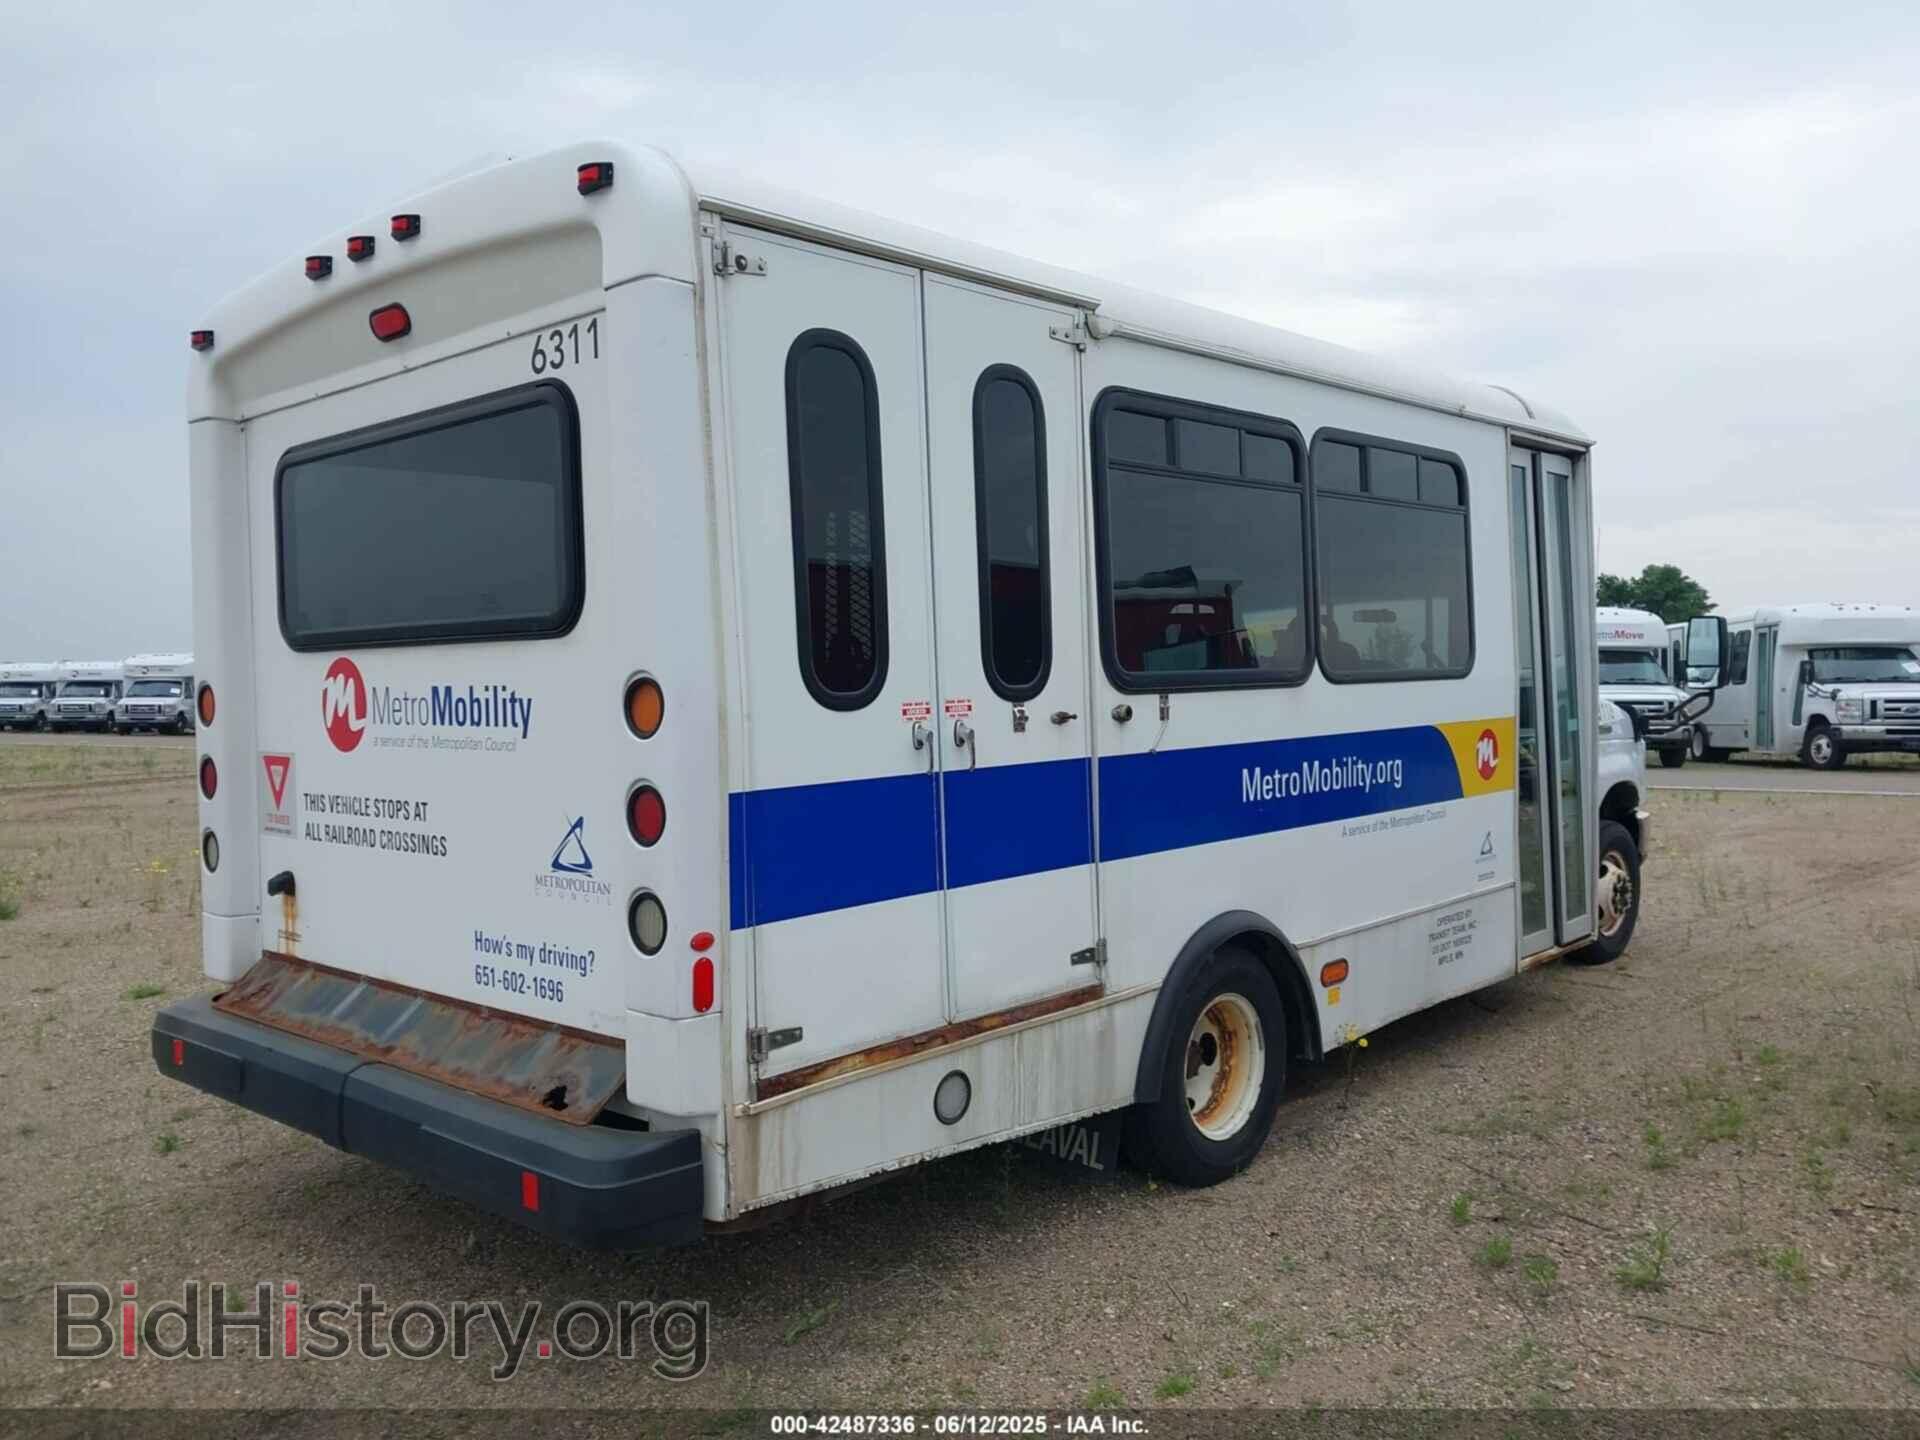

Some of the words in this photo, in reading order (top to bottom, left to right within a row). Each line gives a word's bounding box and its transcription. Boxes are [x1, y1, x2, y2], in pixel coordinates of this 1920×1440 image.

[531, 317, 599, 374] 6311
[371, 685, 532, 739] MetroMobility
[431, 736, 482, 751] Metropolitan
[484, 737, 517, 751] Council
[1242, 755, 1403, 803] MetroMobility.org
[303, 793, 326, 813] THIS
[327, 794, 371, 817] VEHICLE
[373, 798, 410, 820] STOPS
[414, 801, 428, 822] AT
[304, 821, 322, 842] ALL
[324, 824, 377, 848] RAILROAD
[379, 829, 448, 857] CROSSINGS
[535, 873, 611, 895] METROPOLITAN
[474, 930, 513, 957] How's
[516, 943, 535, 967] my
[539, 942, 596, 977] driving?
[474, 964, 564, 1003] 651-602-1696
